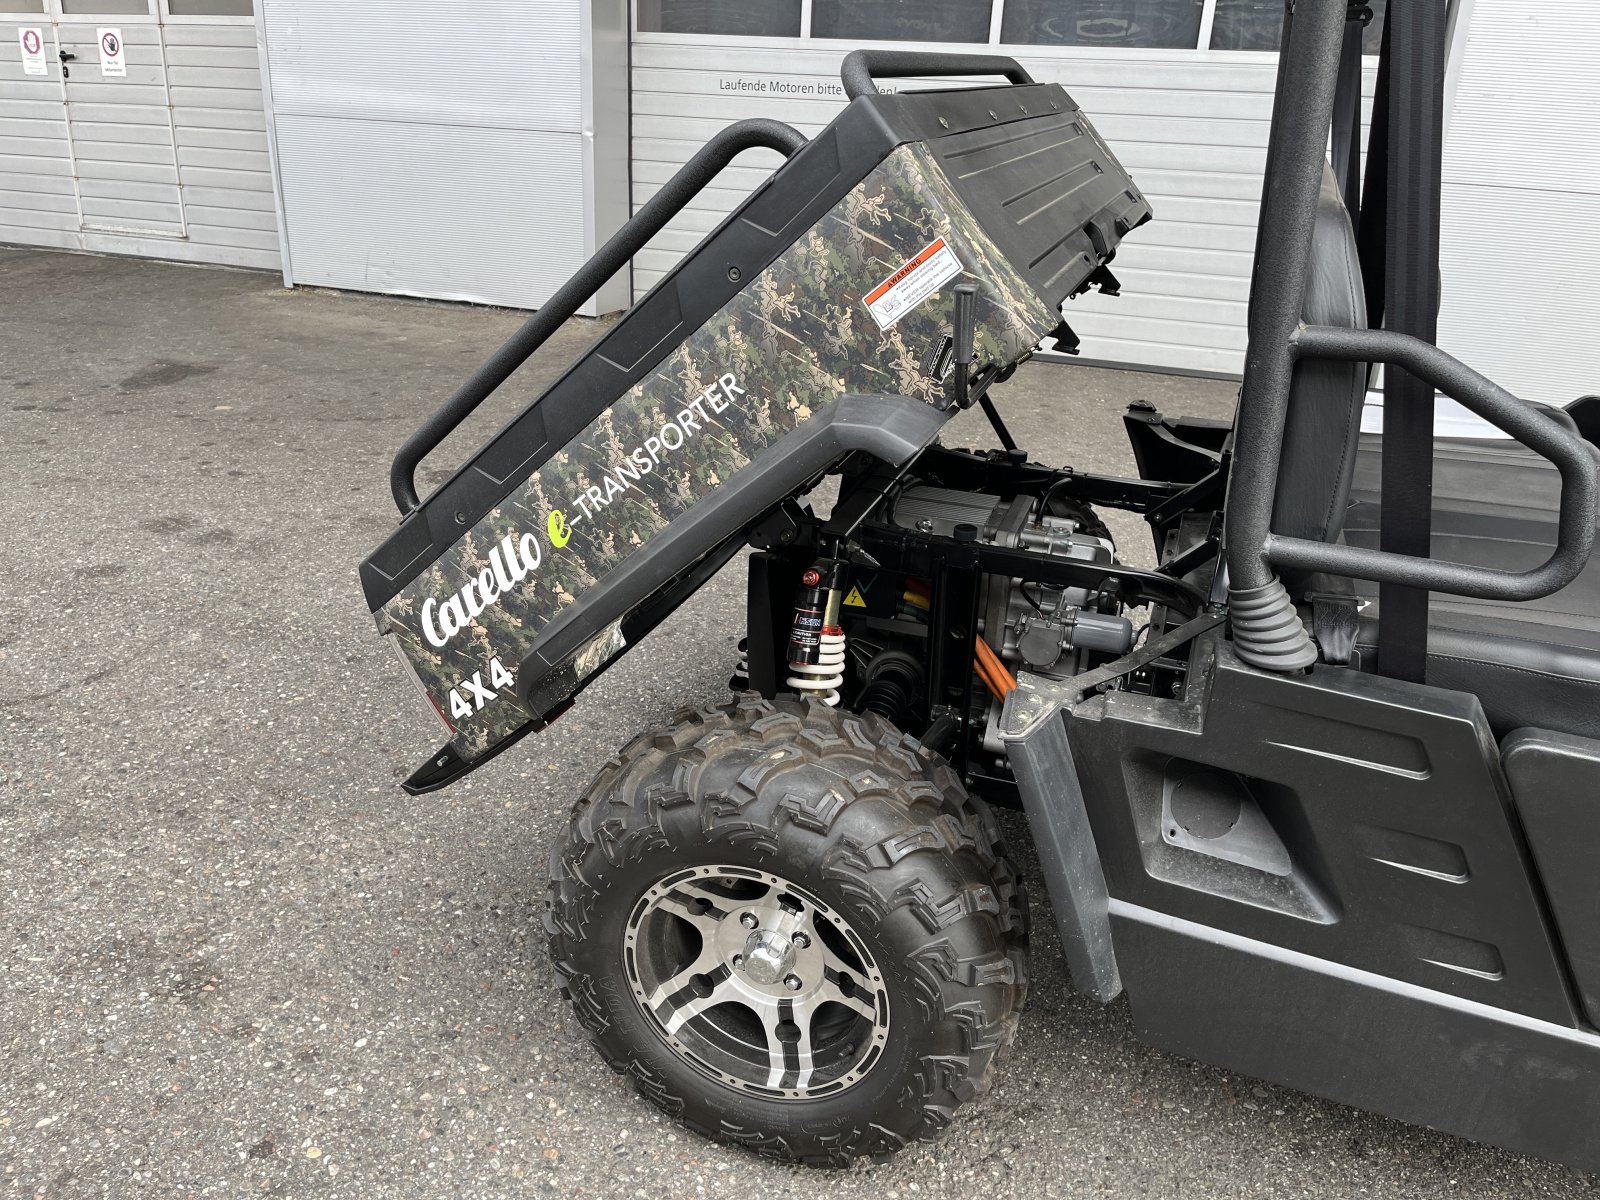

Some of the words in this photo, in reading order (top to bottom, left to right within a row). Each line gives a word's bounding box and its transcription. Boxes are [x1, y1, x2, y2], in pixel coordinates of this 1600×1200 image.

[720, 79, 766, 92] Laufende
[769, 81, 814, 94] Motoren
[818, 83, 842, 95] bitte
[420, 532, 542, 648] Carello
[448, 656, 515, 721] 4X4
